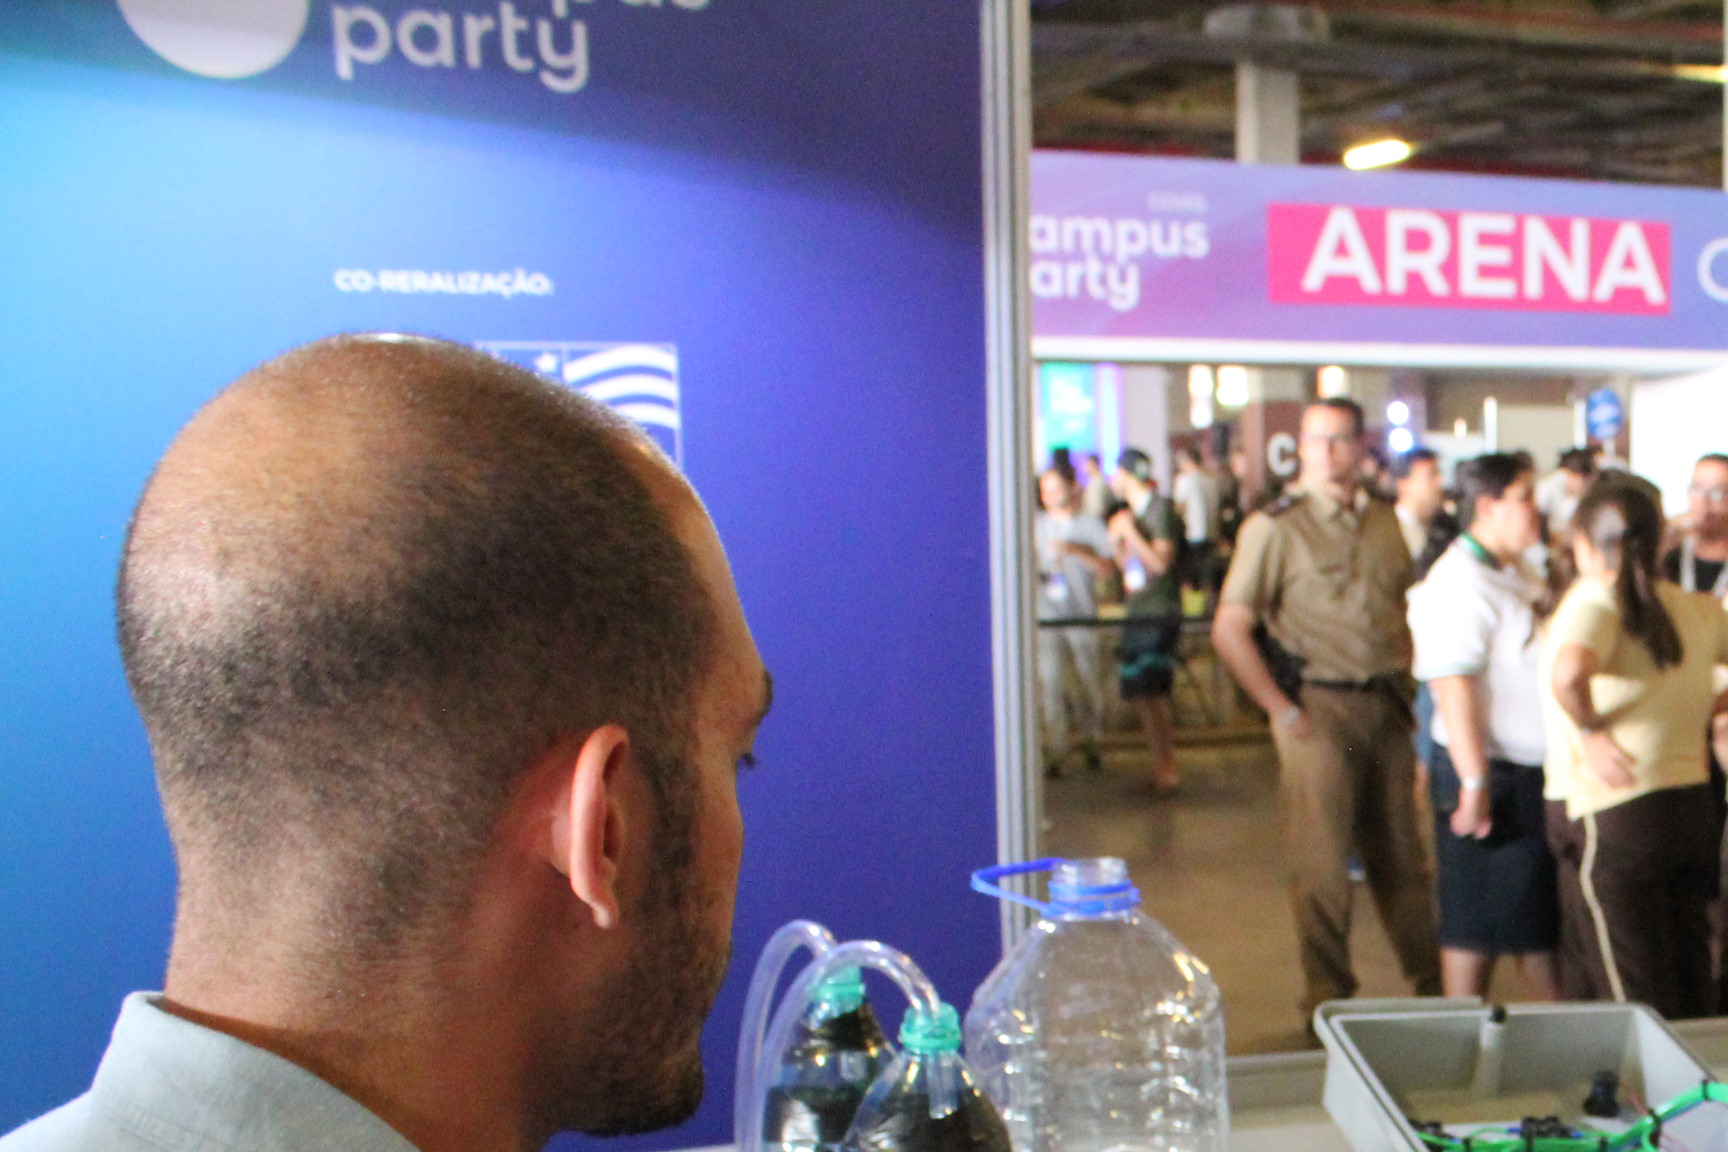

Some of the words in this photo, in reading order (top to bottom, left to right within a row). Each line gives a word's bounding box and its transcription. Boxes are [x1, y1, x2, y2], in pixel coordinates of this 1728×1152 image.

[331, 0, 589, 93] party
[1029, 214, 1210, 264] ampus
[1302, 206, 1668, 305] ARENA
[1029, 254, 1141, 313] arty
